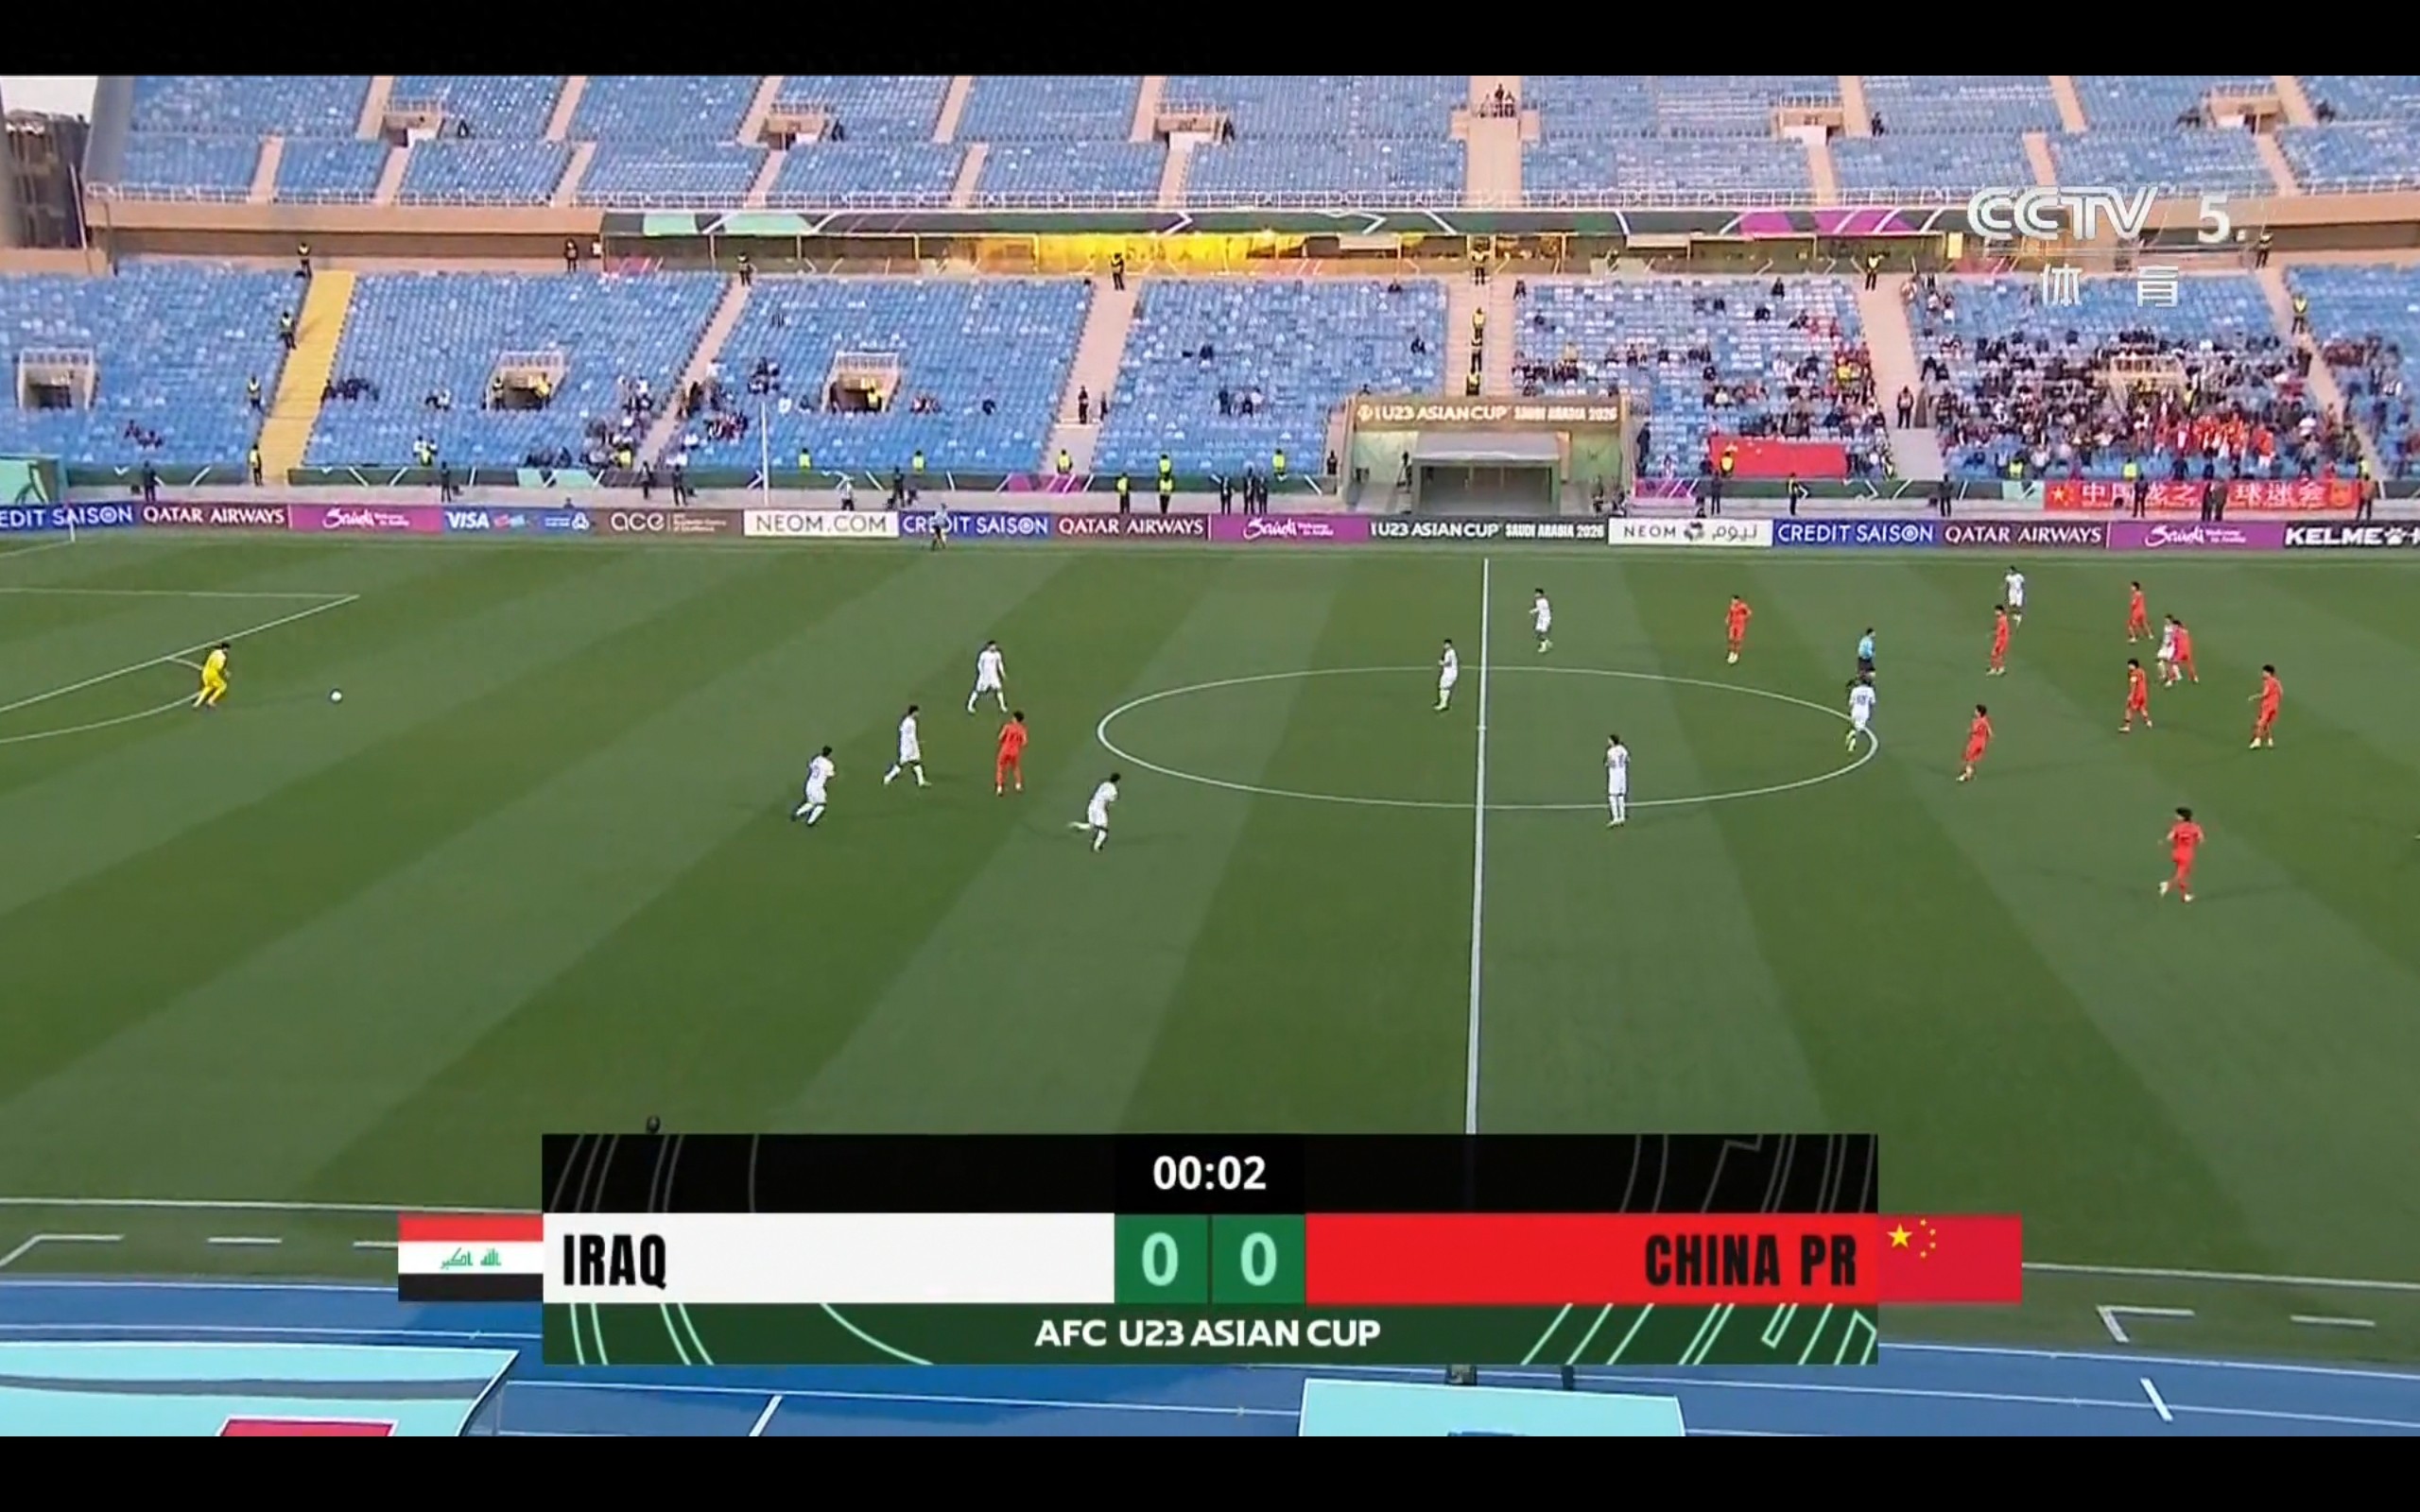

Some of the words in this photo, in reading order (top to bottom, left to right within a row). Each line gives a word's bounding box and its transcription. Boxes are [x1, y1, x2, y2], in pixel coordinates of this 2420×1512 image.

[1384, 405, 1414, 420] U23
[1417, 405, 1468, 421] ASIAN
[1471, 405, 1506, 420] CUP
[2082, 479, 2327, 505] 中国龙之球迷会
[52, 506, 132, 526] SAISON
[143, 506, 203, 523] QATAR
[210, 507, 285, 524] AIRWAYS
[445, 511, 490, 529] VISA
[611, 512, 665, 531] ace
[756, 513, 887, 533] NEOM.COM
[976, 516, 1048, 535] SAISON
[1058, 517, 1119, 536] QATAR
[1126, 519, 1204, 535] AIRWAYS
[1377, 523, 1409, 538] U23
[1411, 522, 1462, 538] ASIAN
[1463, 522, 1498, 538] CUP
[1505, 523, 1536, 538] SAUDI
[1537, 524, 1575, 539] ARABIA
[1576, 524, 1605, 539] 2026
[1623, 525, 1677, 539] NEOM
[1777, 524, 1851, 542] CREDIT
[1856, 524, 1934, 543] SAISON
[1945, 525, 2010, 544] QATAR
[2018, 526, 2101, 543] AIRWAYS
[2285, 526, 2384, 546] KELME
